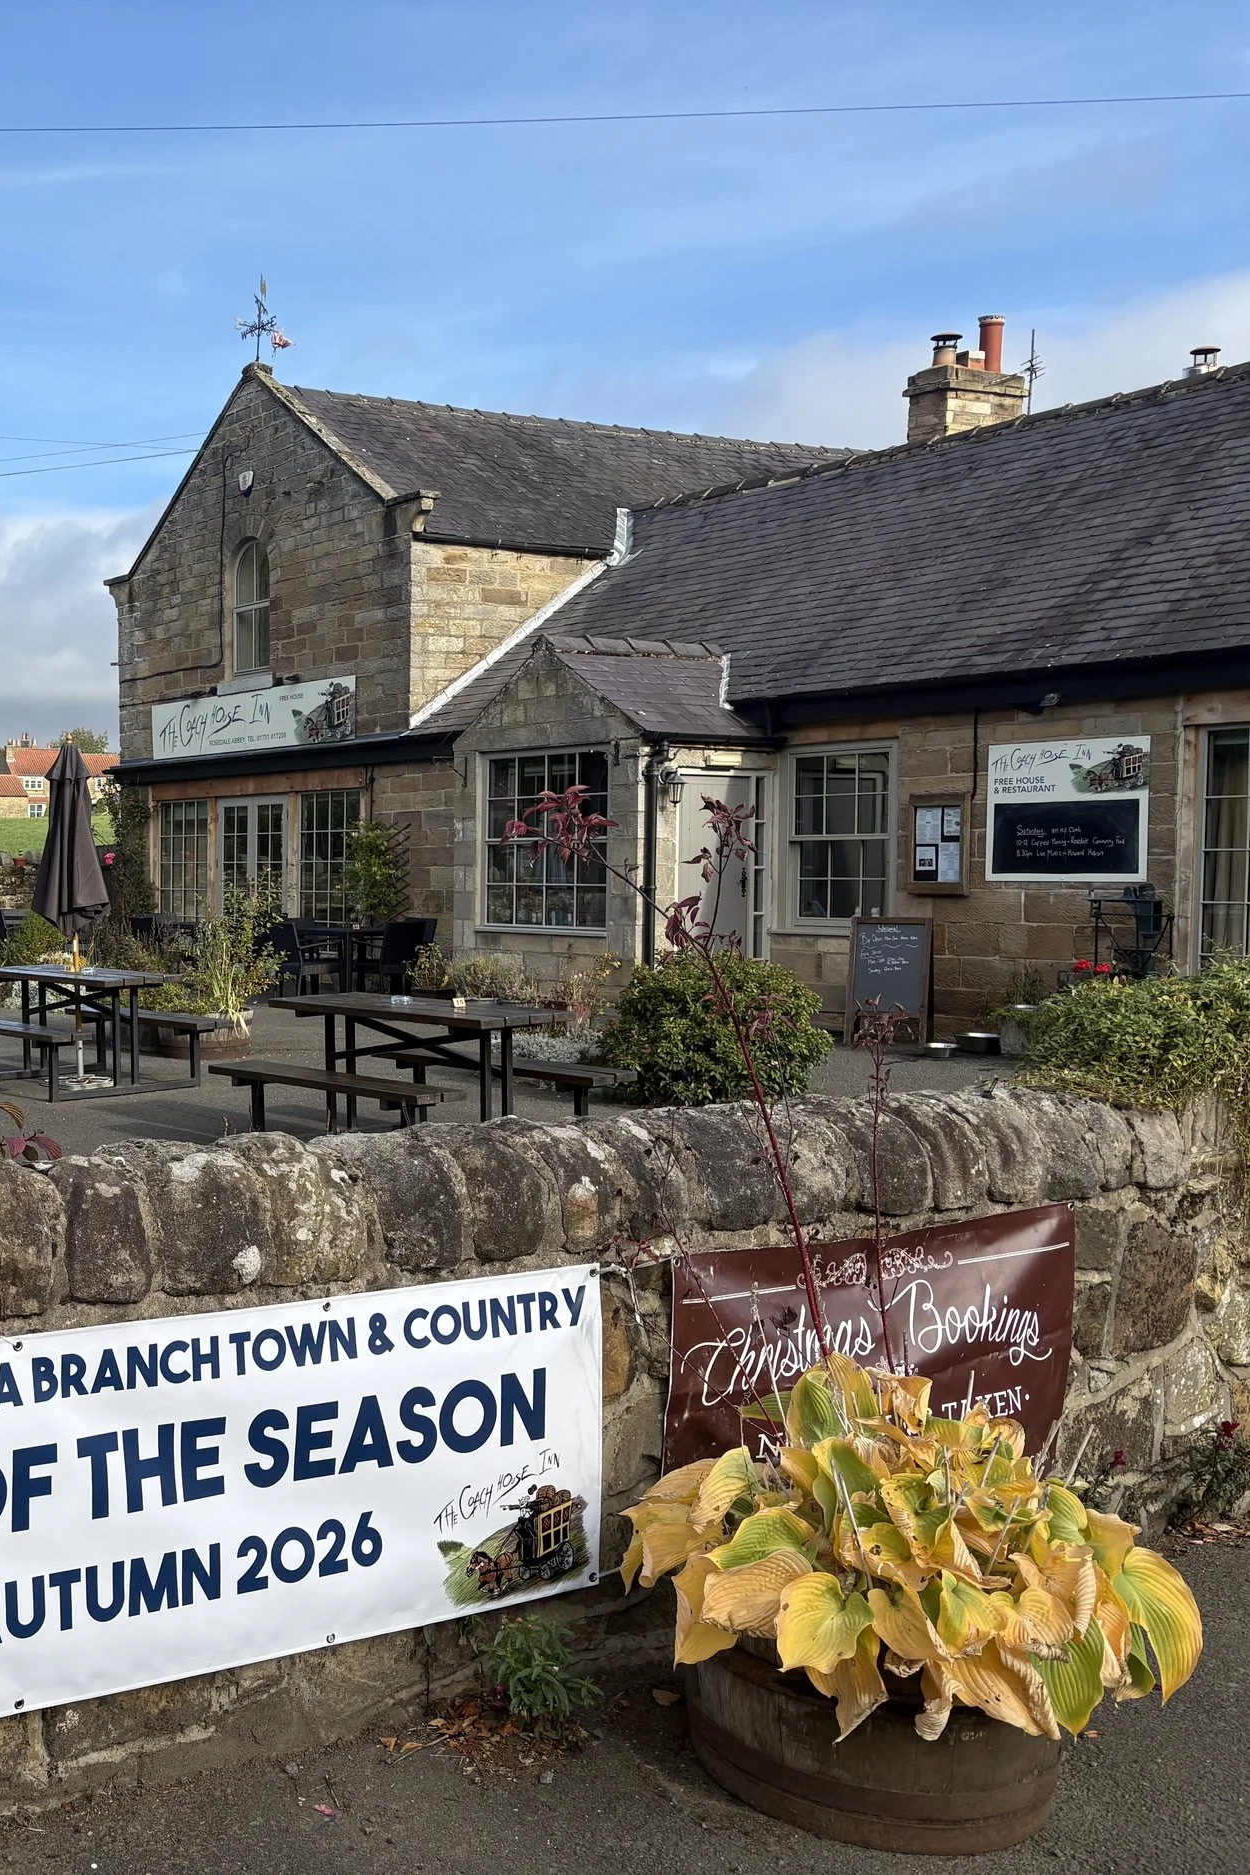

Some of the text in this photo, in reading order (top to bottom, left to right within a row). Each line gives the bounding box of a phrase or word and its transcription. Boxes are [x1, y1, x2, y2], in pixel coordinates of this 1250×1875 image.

[249, 693, 272, 724] INN
[290, 692, 304, 700] HOUSE
[210, 738, 231, 747] ROSEDALE
[257, 734, 270, 742] 01751
[993, 784, 1056, 795] & RESTAURANT
[994, 775, 1045, 786] FREE HOUSE
[32, 1335, 222, 1404] BRANCH
[230, 1317, 358, 1376] TOWN
[368, 1312, 395, 1355] &
[403, 1285, 587, 1349] COUNTRY
[867, 1279, 1052, 1366] Bookings
[77, 1417, 227, 1520] THE
[244, 1367, 547, 1488] SEASON
[433, 1448, 561, 1534] THE COACH HOUSE INN
[238, 1511, 383, 1595] 2026
